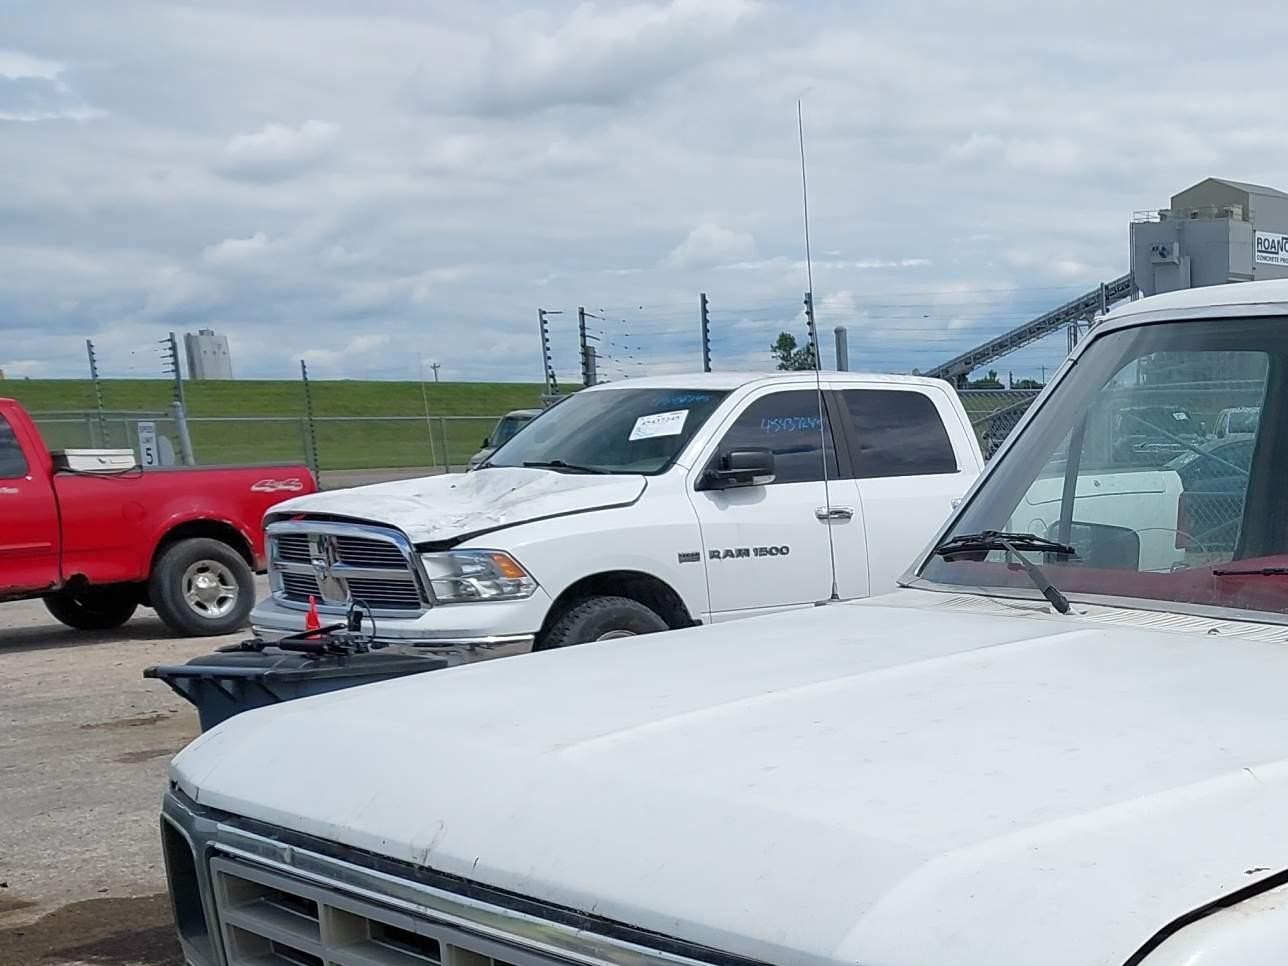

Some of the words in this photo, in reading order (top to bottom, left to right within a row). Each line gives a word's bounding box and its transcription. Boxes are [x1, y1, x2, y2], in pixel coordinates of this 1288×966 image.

[1257, 254, 1279, 263] CONCRETE
[145, 447, 154, 465] 5
[708, 548, 750, 560] RAM
[752, 545, 790, 557] 1500
